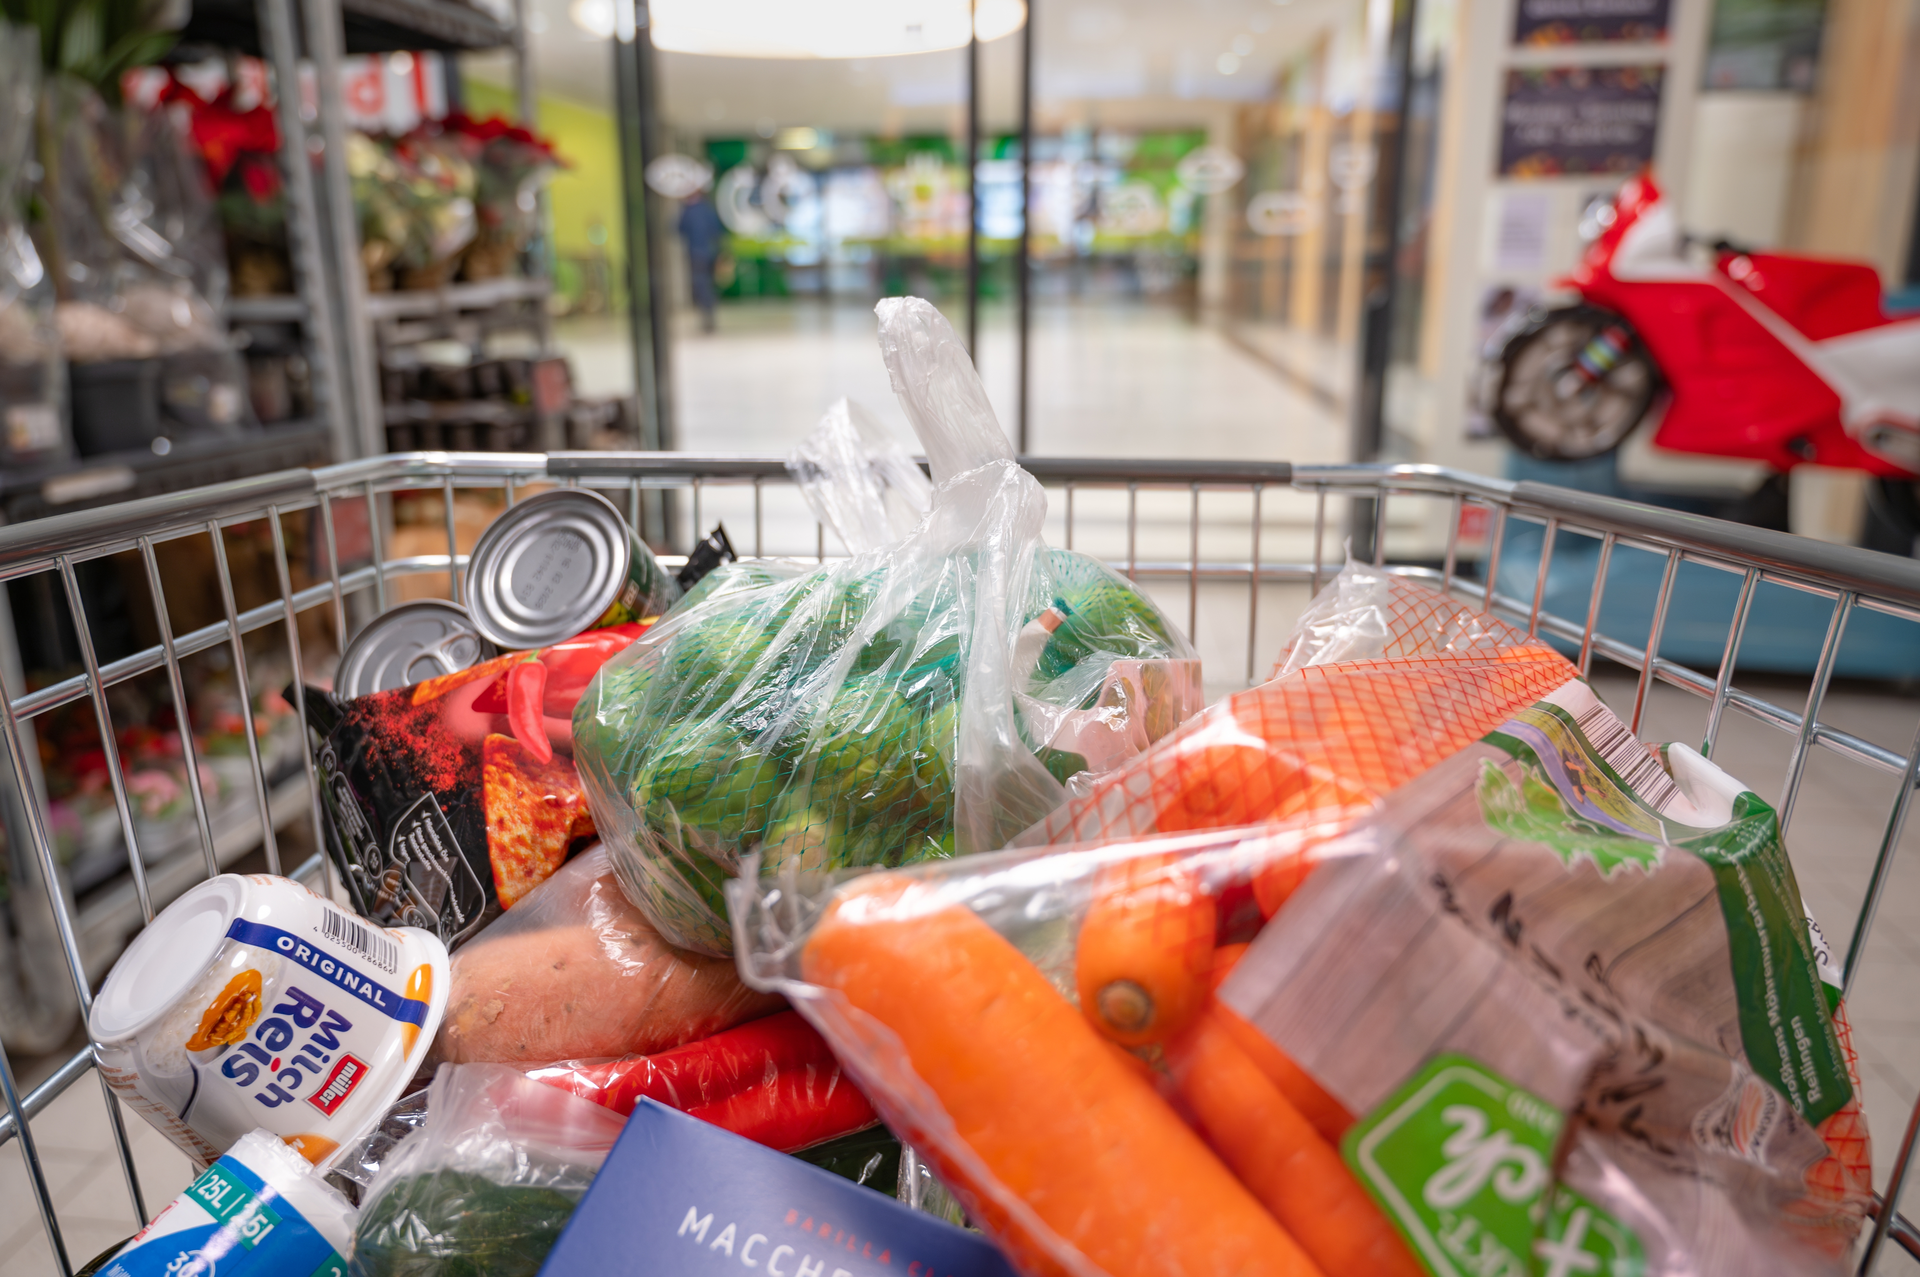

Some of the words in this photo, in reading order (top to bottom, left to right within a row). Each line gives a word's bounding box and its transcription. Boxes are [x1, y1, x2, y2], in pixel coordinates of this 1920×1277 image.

[424, 817, 443, 852] Pflanzliche
[440, 848, 449, 863] Öle
[276, 936, 387, 1007] ORIGINAL
[324, 931, 358, 955] 025500
[360, 951, 394, 975] 286866
[221, 986, 325, 1087] Reis
[254, 1009, 353, 1108] Milch
[1790, 1015, 1823, 1105] Reilingen
[318, 1061, 358, 1107] müller
[1773, 1025, 1804, 1116] Großhans
[196, 1173, 233, 1210] 25L
[784, 1208, 891, 1265] BARILLA
